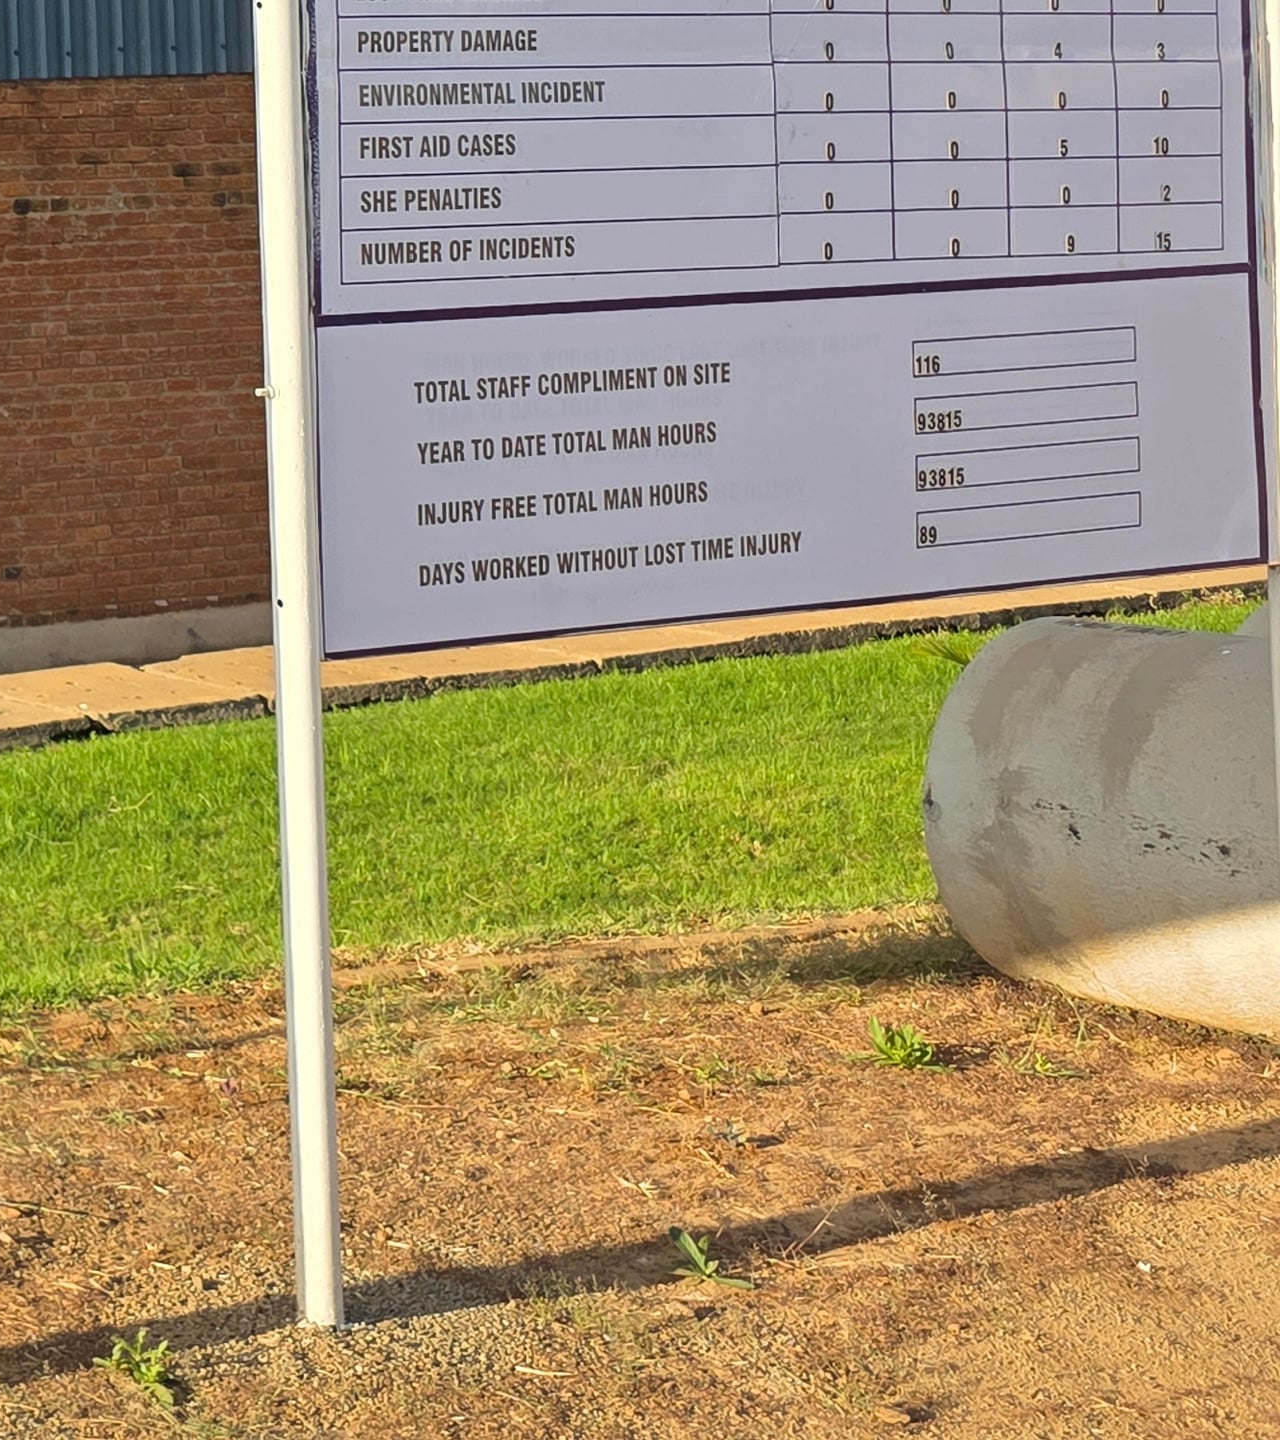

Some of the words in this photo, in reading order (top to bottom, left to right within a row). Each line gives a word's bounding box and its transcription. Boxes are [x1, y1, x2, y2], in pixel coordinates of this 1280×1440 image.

[358, 30, 454, 52] PROPERTY
[462, 30, 537, 52] DAMAGE
[1054, 42, 1062, 59] 4
[1157, 42, 1165, 60] 3
[360, 83, 516, 106] ENVIRONMENTAL
[522, 82, 605, 103] INCIDENT
[360, 136, 413, 158] FIRST
[420, 136, 450, 157] AID
[458, 134, 515, 156] CASES
[1059, 139, 1069, 156] 5
[1153, 137, 1170, 155] 10
[361, 190, 396, 213] SHE
[405, 187, 501, 211] PENALTIES
[1163, 185, 1171, 201] 2
[362, 241, 442, 265] NUMBER
[450, 240, 472, 262] OF
[480, 236, 574, 260] INCIDENTS
[1066, 235, 1075, 253] 9
[1156, 232, 1171, 250] 15
[915, 356, 940, 373] 116
[414, 380, 470, 404] TOTAL
[477, 376, 530, 400] STAFF
[538, 367, 657, 395] COMPLIMENT
[664, 365, 686, 387] ON
[694, 362, 730, 385] SITE
[918, 410, 961, 430] 93815
[418, 441, 464, 464] YEAR
[472, 438, 494, 460] TO
[502, 434, 546, 458] DATE
[552, 430, 606, 454] TOTAL
[612, 427, 651, 450] MAN
[658, 422, 716, 446] HOURS
[919, 468, 964, 488] 93815
[418, 500, 484, 526] INJURY
[492, 496, 536, 520] FREE
[543, 491, 598, 515] TOTAL
[604, 487, 642, 510] MAN
[650, 481, 707, 506] HOURS
[920, 526, 936, 544] 89
[420, 562, 464, 586] DAYS
[472, 555, 549, 581] WORKED
[557, 547, 638, 574] WITHOUT
[645, 542, 685, 566] LOST
[691, 538, 733, 561] TIME
[741, 532, 801, 556] INJURY
